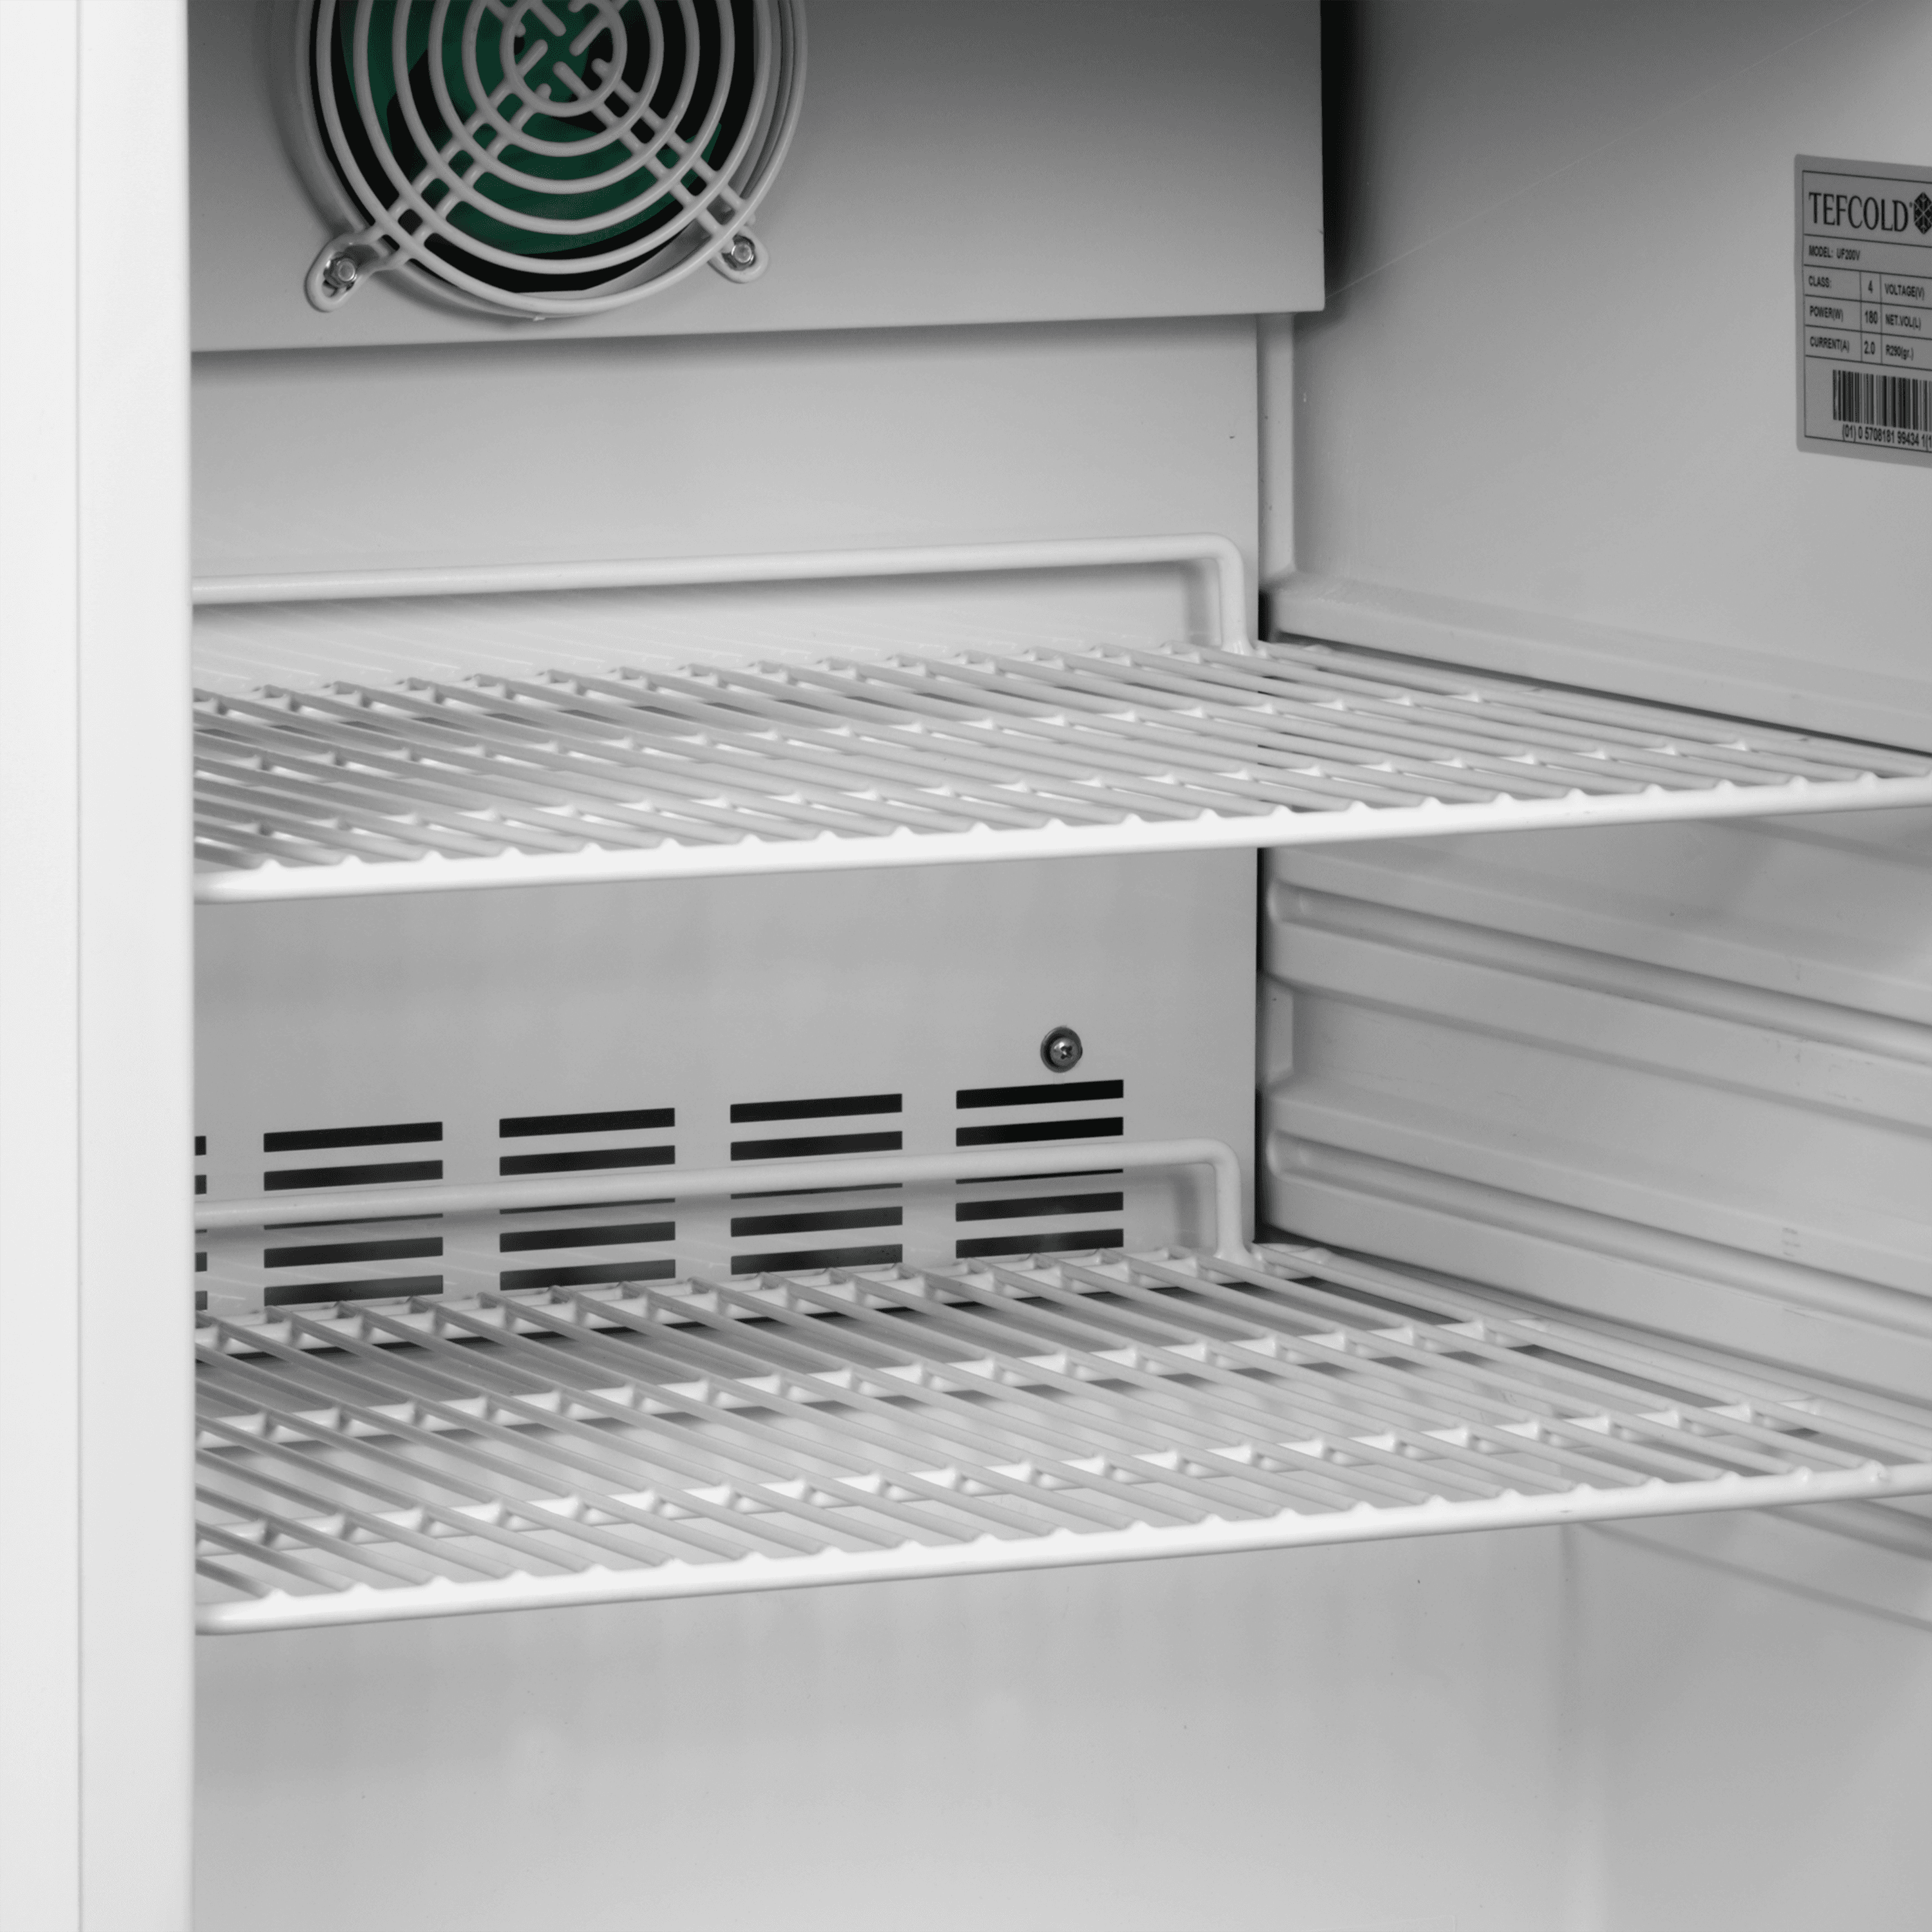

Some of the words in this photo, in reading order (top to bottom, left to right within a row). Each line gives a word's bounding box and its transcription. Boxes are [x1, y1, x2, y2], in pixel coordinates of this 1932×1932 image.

[1808, 191, 1909, 232] TEFCOLD
[1808, 245, 1833, 258] MODEL:
[1836, 247, 1861, 261] UF200V
[1808, 275, 1832, 289] CLASS:
[1868, 279, 1873, 294] 4
[1884, 283, 1925, 301] VOLTAGE(V)
[1810, 305, 1844, 323] POWER(W)
[1864, 310, 1879, 325] 180
[1885, 313, 1922, 331] NET.VOL(L)
[1810, 336, 1850, 354] CURRENT(A)
[1864, 340, 1876, 355] 2.0
[1842, 423, 1857, 443] (01)
[1857, 426, 1863, 440] 0
[1864, 426, 1895, 444] 5708181
[1897, 430, 1920, 447] 99434
